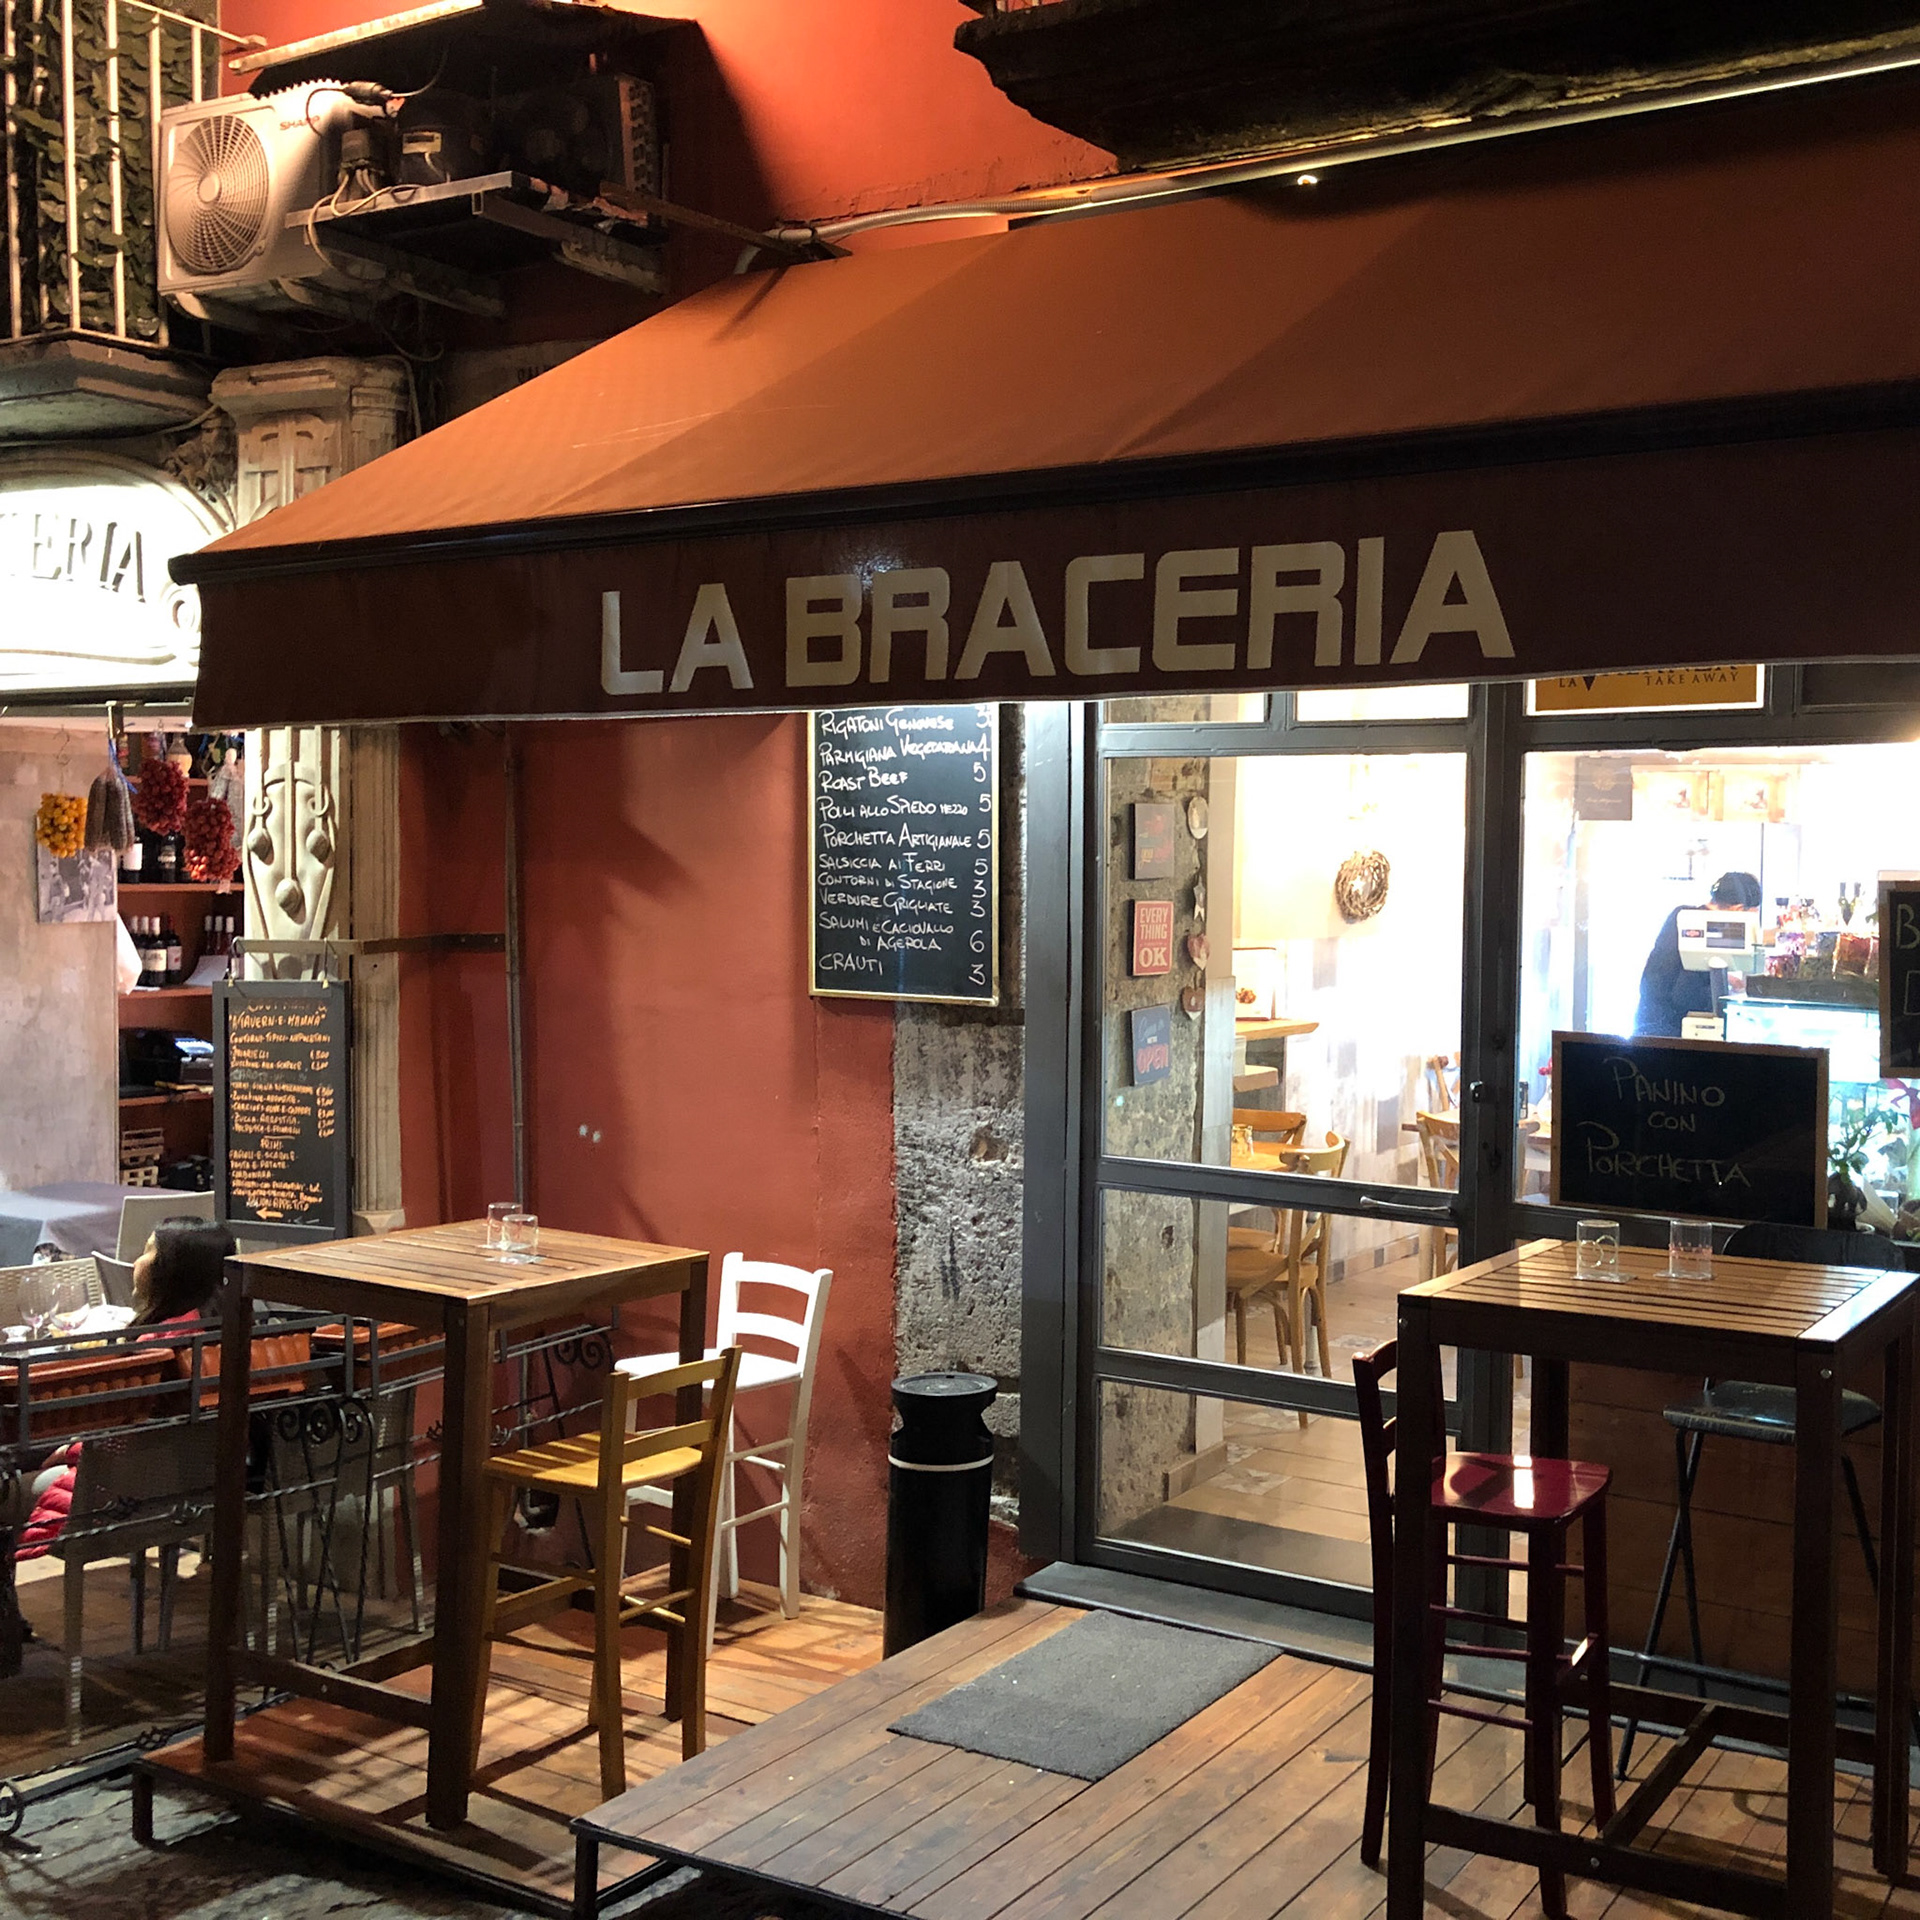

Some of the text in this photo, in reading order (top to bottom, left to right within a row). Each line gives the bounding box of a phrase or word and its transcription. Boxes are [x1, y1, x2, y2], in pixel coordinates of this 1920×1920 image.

[600, 530, 1515, 696] LA BRACERIA
[1559, 677, 1577, 688] LA
[1644, 673, 1685, 686] TAKE
[1692, 671, 1739, 685] AWAY
[818, 710, 884, 740] RIGATONI
[819, 741, 897, 769] PARMIGIANA
[974, 733, 990, 761] 4
[818, 761, 987, 793] ROAST BEEF 5
[860, 805, 889, 819] ALLO
[886, 795, 937, 815] SPIEDO
[979, 793, 991, 812] 5
[819, 822, 991, 851] PORCHETTA ARTIGIANALE 5
[818, 852, 988, 876] SALSICCIA AI FERRI 5
[817, 872, 987, 899] CONTORNI DI STAGIONE 3
[819, 887, 986, 918] VERDURE GRIGLIATE 3
[1140, 907, 1168, 923] EVERY
[819, 911, 954, 935] SALUMI E CACIOVALLO
[1140, 923, 1168, 940] THING
[859, 930, 985, 953] DI AGEROLA 6
[818, 952, 986, 986] CRAUTI 3
[1139, 947, 1168, 968] OK
[1602, 1056, 1725, 1108] PANINO
[1647, 1110, 1696, 1133] CON
[1577, 1119, 1751, 1188] PORCHETTA
